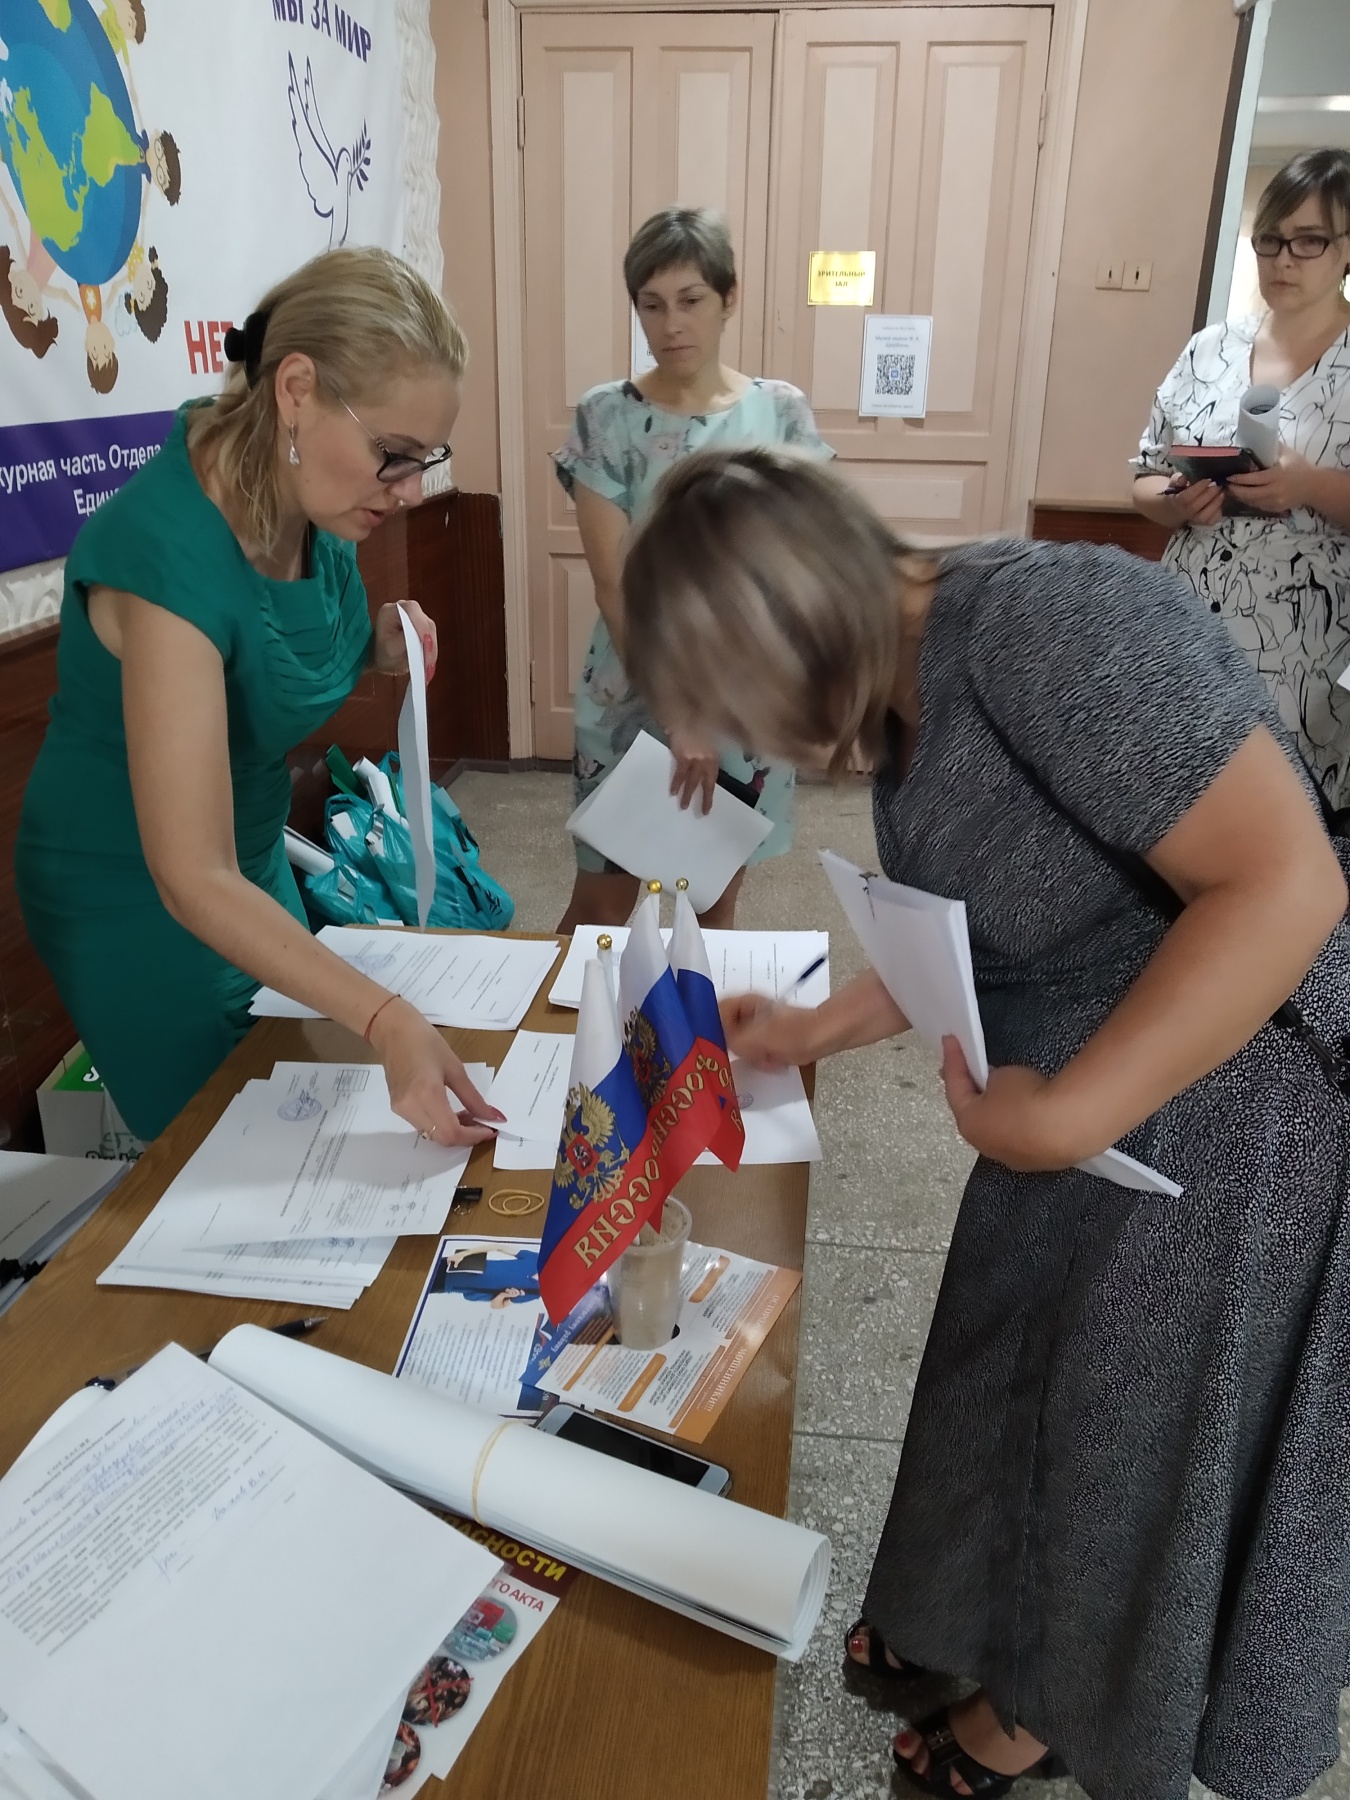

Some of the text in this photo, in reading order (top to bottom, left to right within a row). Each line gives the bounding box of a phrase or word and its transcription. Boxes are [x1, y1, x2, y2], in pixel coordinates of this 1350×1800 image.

[272, 0, 371, 63] МЫ ЗА МИР
[60, 453, 106, 477] часть
[509, 1589, 545, 1613] АКТА
